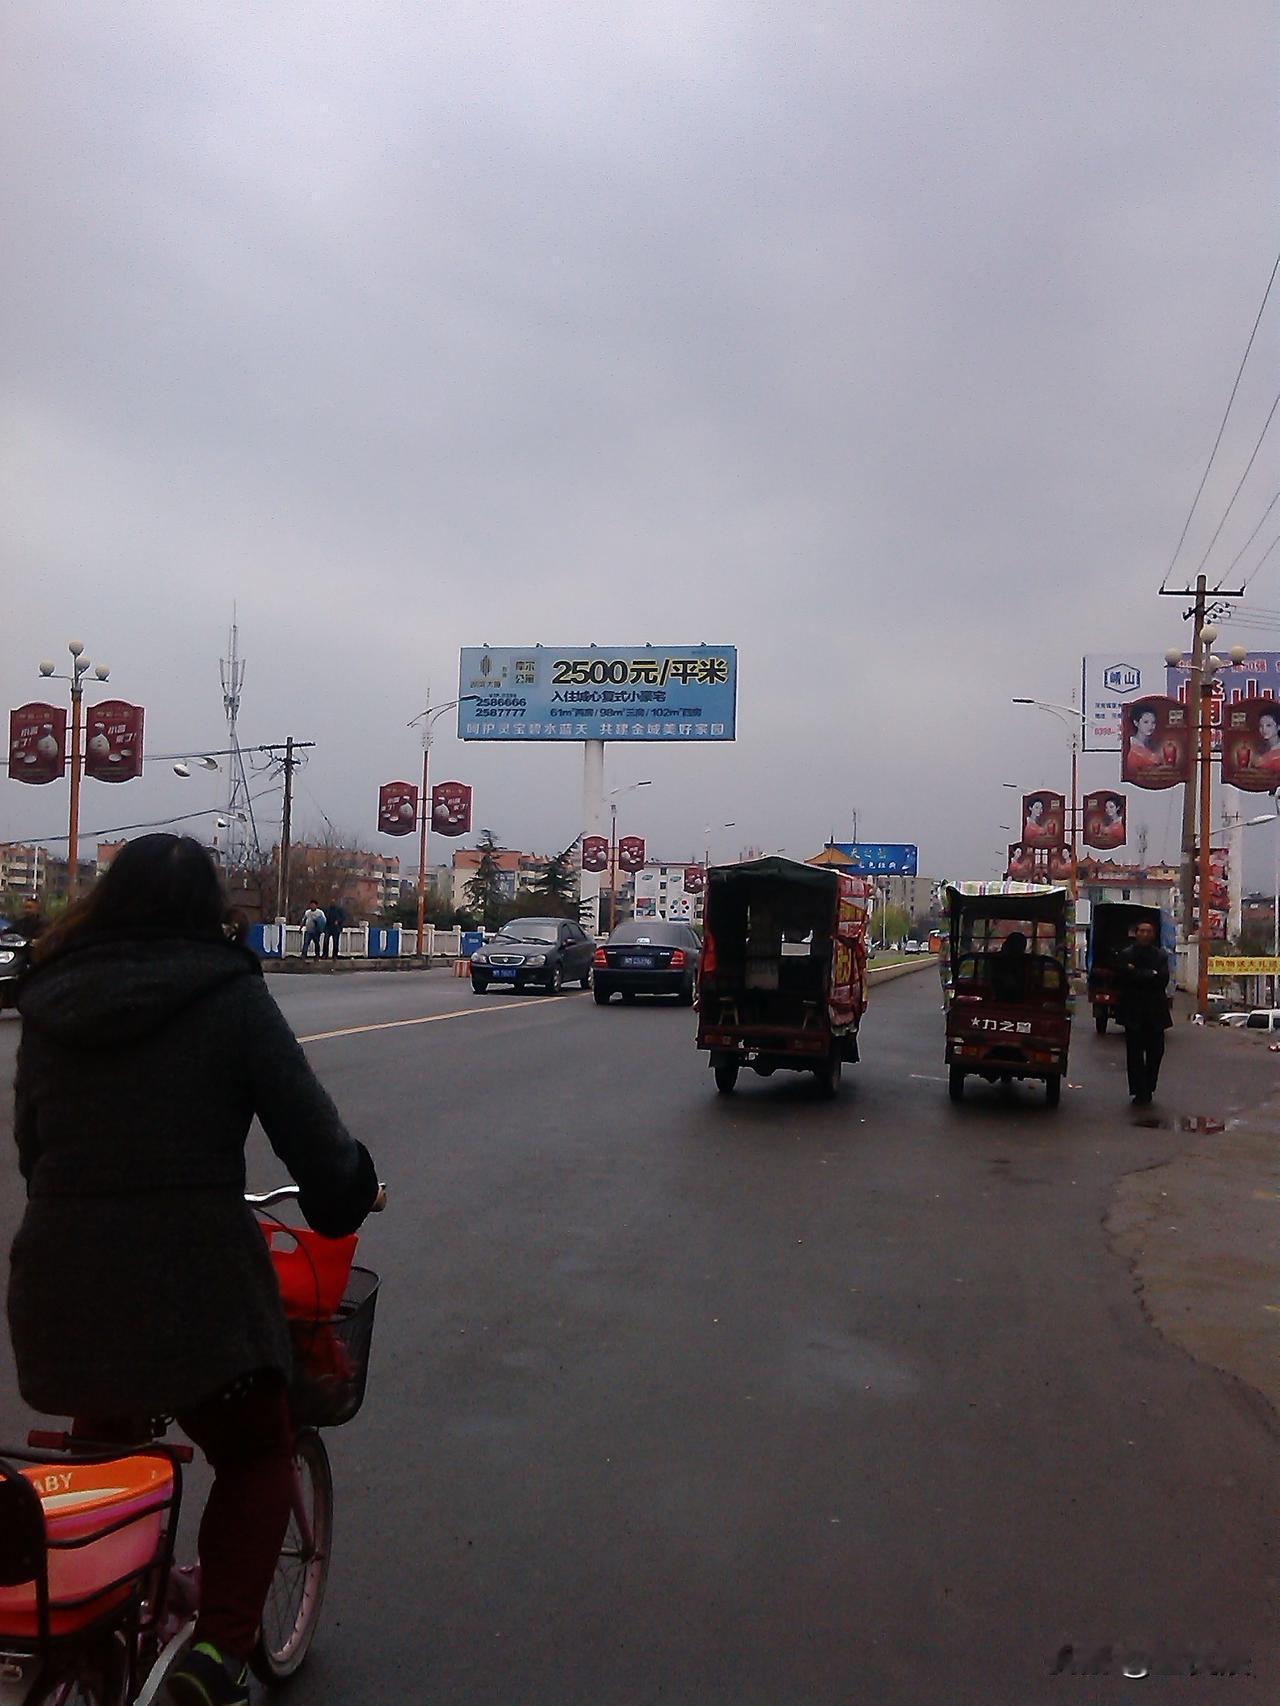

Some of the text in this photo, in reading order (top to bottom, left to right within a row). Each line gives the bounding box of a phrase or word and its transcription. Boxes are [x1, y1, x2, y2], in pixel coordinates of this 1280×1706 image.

[551, 658, 727, 685] 2500元/平米
[476, 698, 527, 707] 2586666
[475, 708, 527, 718] 2587777
[34, 1472, 73, 1492] ABY
